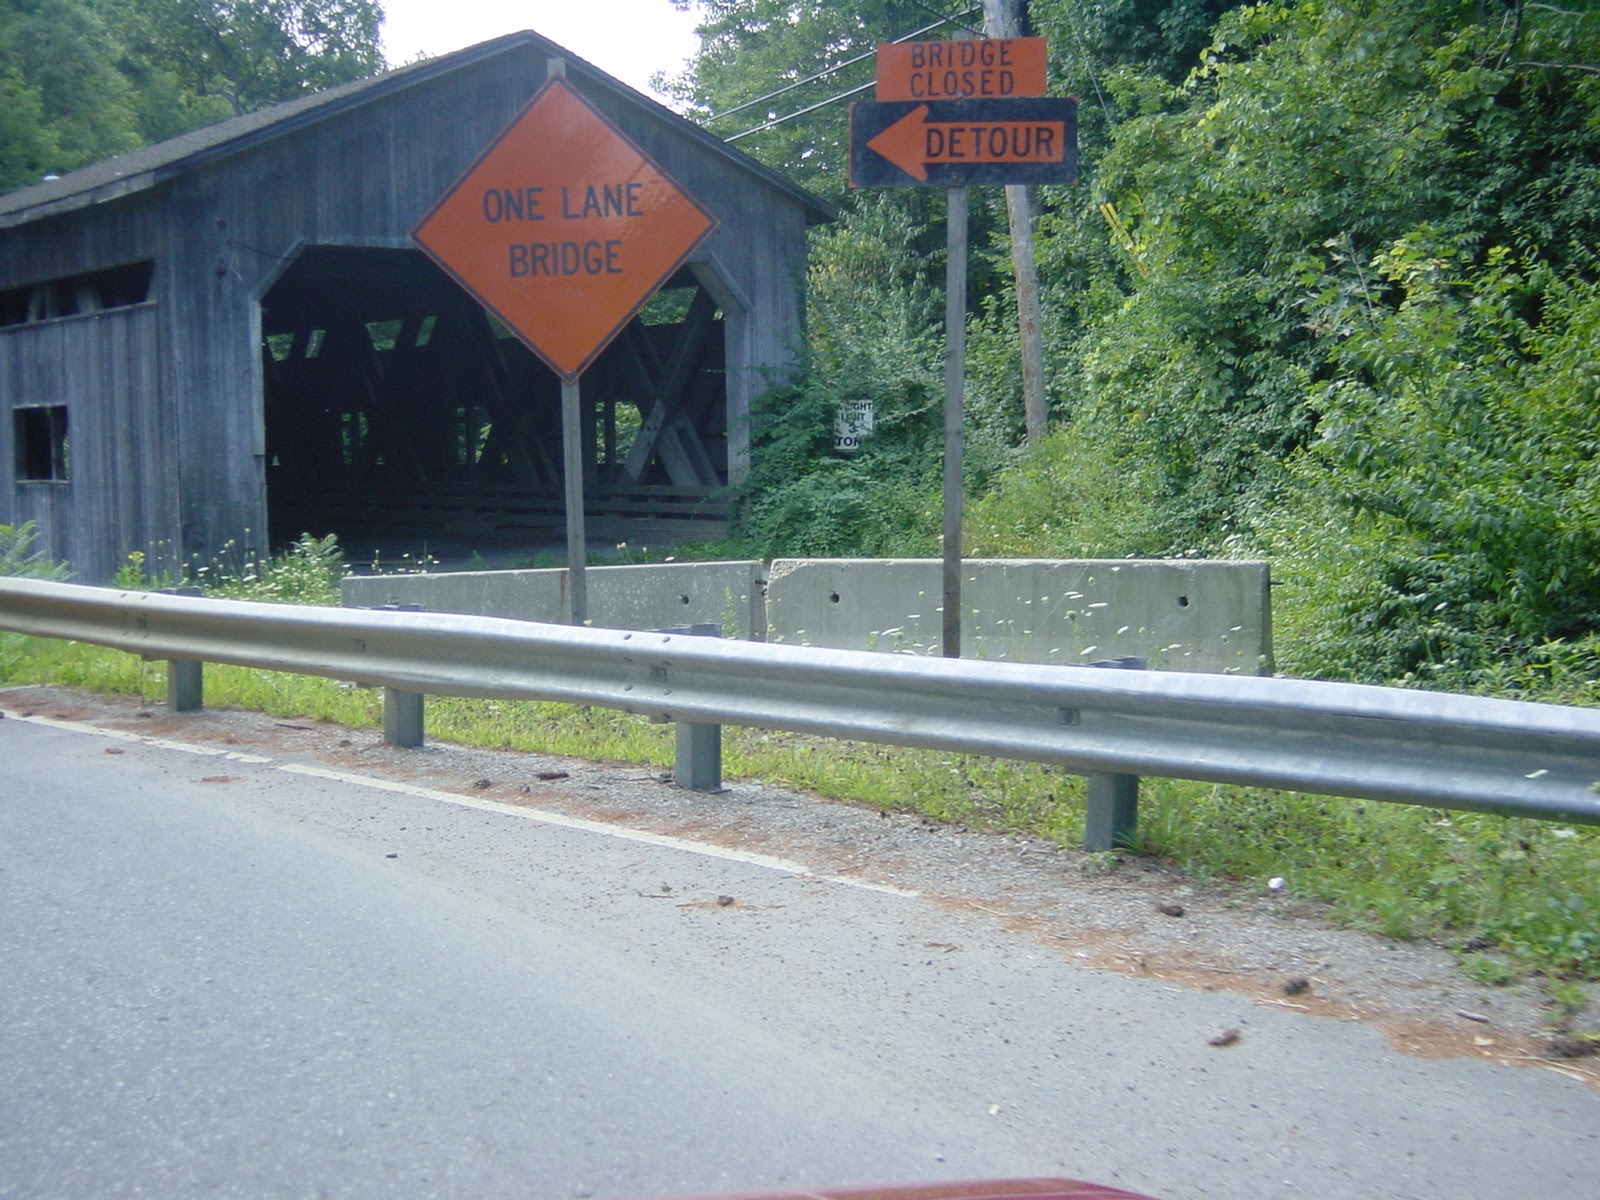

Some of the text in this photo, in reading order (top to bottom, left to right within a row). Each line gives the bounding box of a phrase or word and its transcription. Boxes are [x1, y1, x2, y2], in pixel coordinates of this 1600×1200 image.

[911, 41, 1013, 68] BRIDGE
[910, 70, 1014, 98] CLOSED
[926, 127, 1055, 158] DETOUR
[483, 183, 644, 223] ONE LANE
[509, 240, 624, 278] BRIDGE
